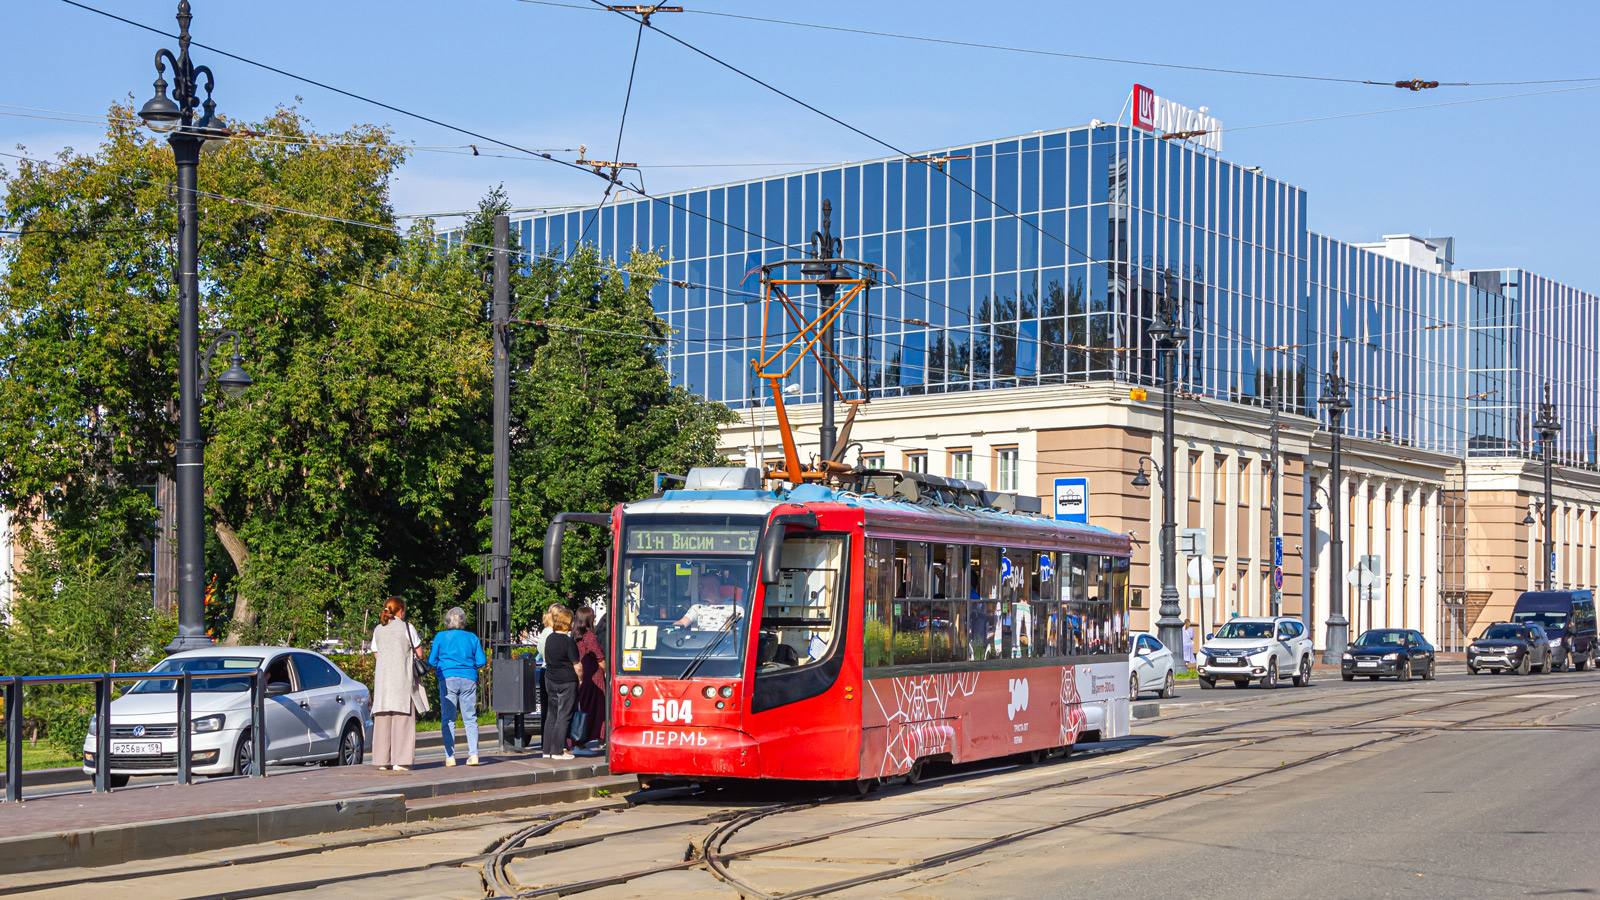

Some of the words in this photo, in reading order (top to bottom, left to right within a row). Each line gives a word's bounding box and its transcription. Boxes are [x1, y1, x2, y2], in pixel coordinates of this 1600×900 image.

[672, 533, 714, 550] Висим
[1009, 566, 1024, 588] 504
[631, 629, 648, 649] 11
[652, 699, 693, 723] 504
[641, 731, 708, 746] ПЕРМЬ
